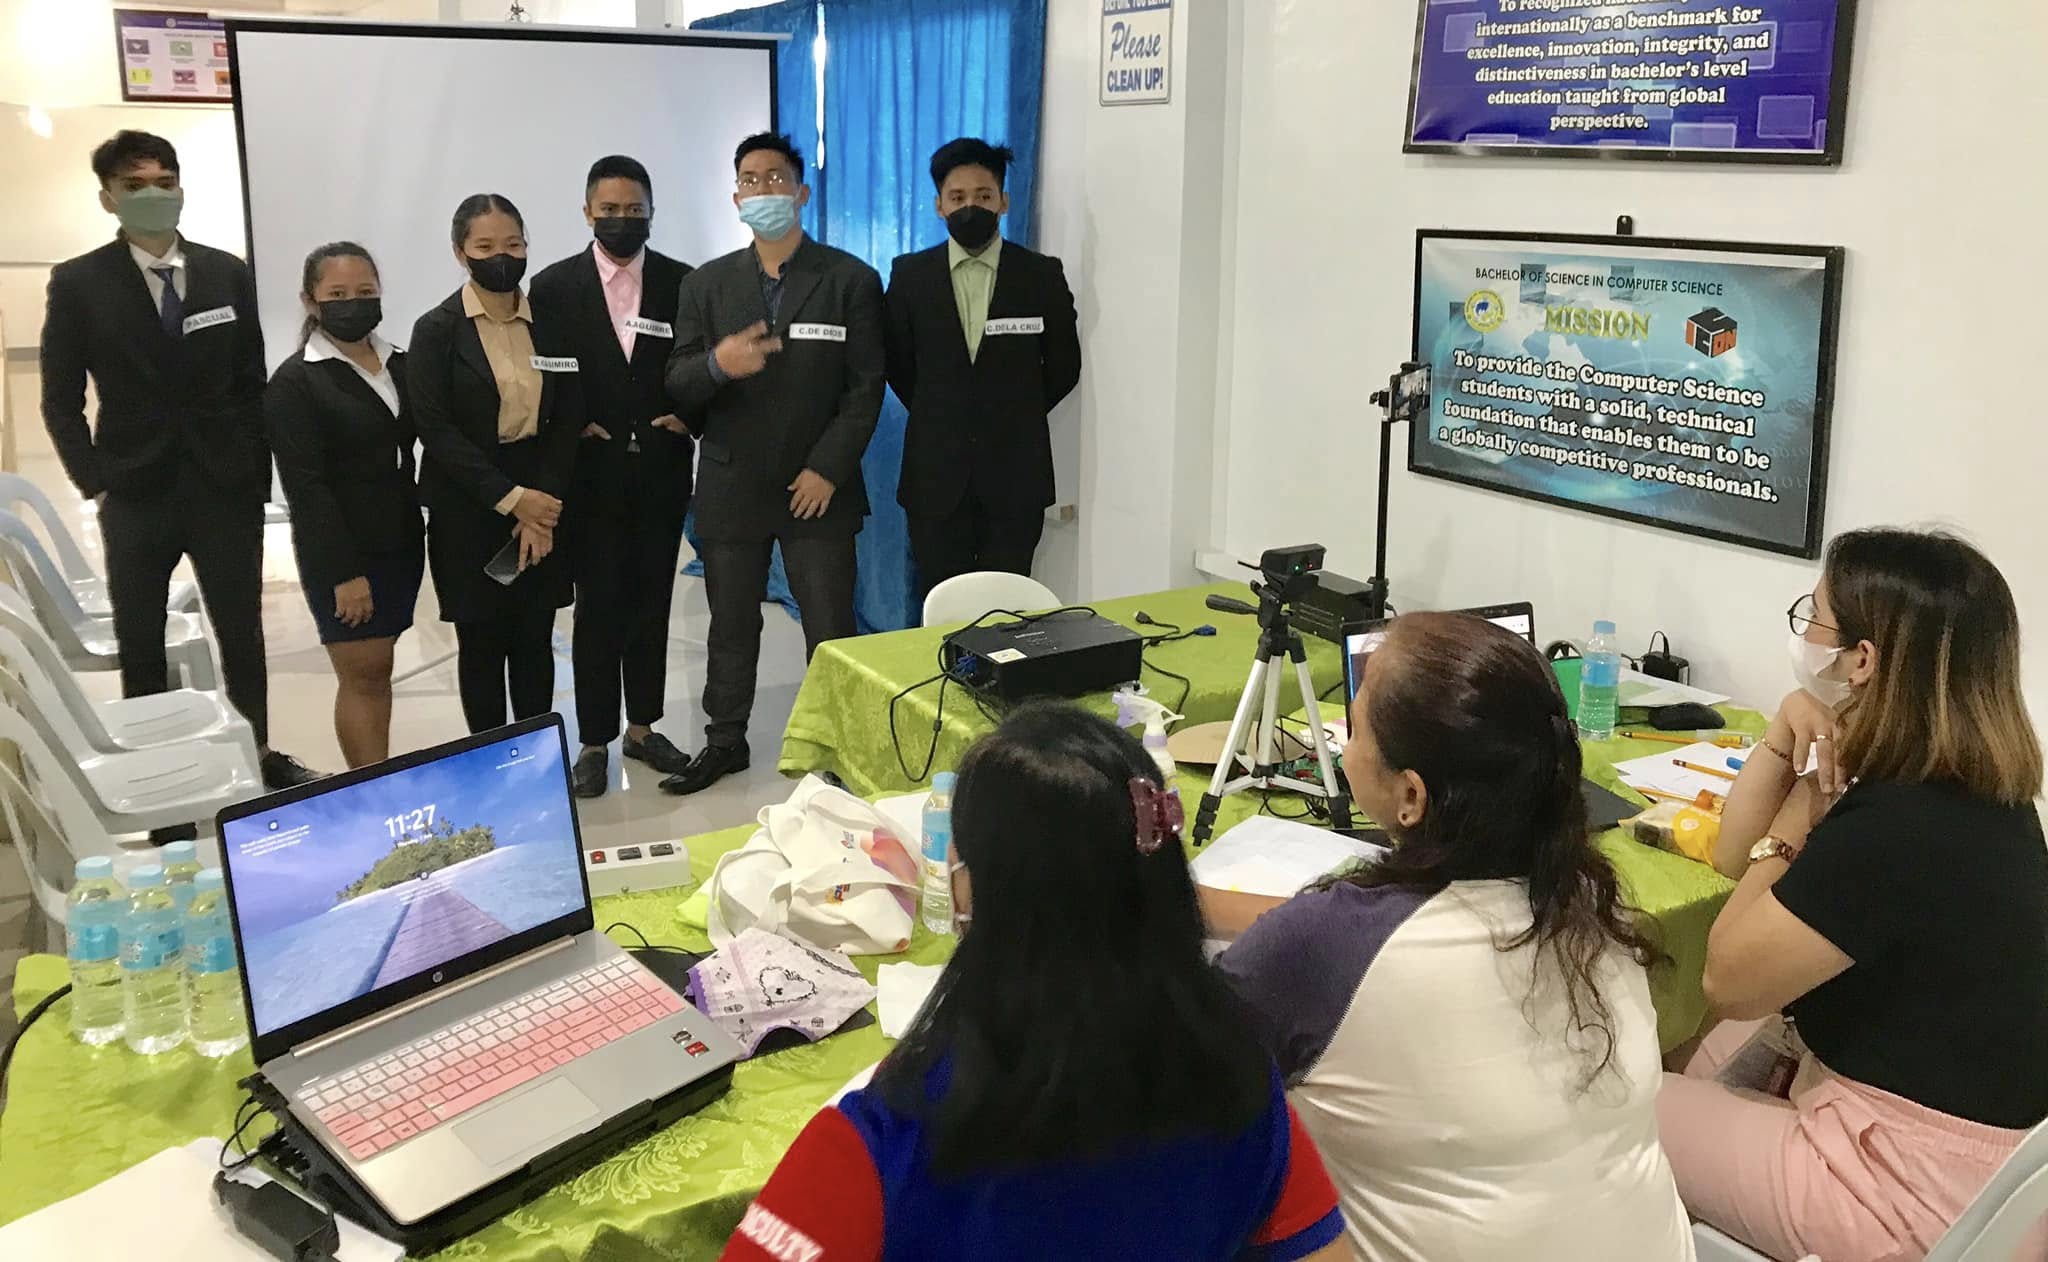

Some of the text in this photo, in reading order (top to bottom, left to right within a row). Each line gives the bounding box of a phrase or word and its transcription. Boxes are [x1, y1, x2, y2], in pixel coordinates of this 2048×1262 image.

[1476, 6, 1762, 37] internationally as a benchmark for
[1500, 0, 1516, 12] To
[1110, 21, 1161, 62] Please
[1467, 31, 1769, 60] excellence, innovation, integrity, and
[1107, 66, 1164, 93] CLEAN UP!
[1475, 59, 1748, 82] distinctiveness in bachelor's level
[1487, 86, 1726, 107] education taught from global
[1549, 113, 1649, 131] perspective.
[1475, 268, 1723, 296] BACHELOR OF SCIENCE IN COMPUTER SCIENCE
[1544, 303, 1651, 342] MISSION
[1454, 350, 1764, 407] To provide the Computer Science
[1461, 379, 1755, 437] students with a solid, technical
[1443, 399, 1770, 469] foundation that enables them to be
[1439, 427, 1448, 440] a
[1451, 428, 1517, 455] globally
[1520, 441, 1628, 473] competitive
[1632, 461, 1778, 502] professionals.
[384, 804, 436, 838] 11:27
